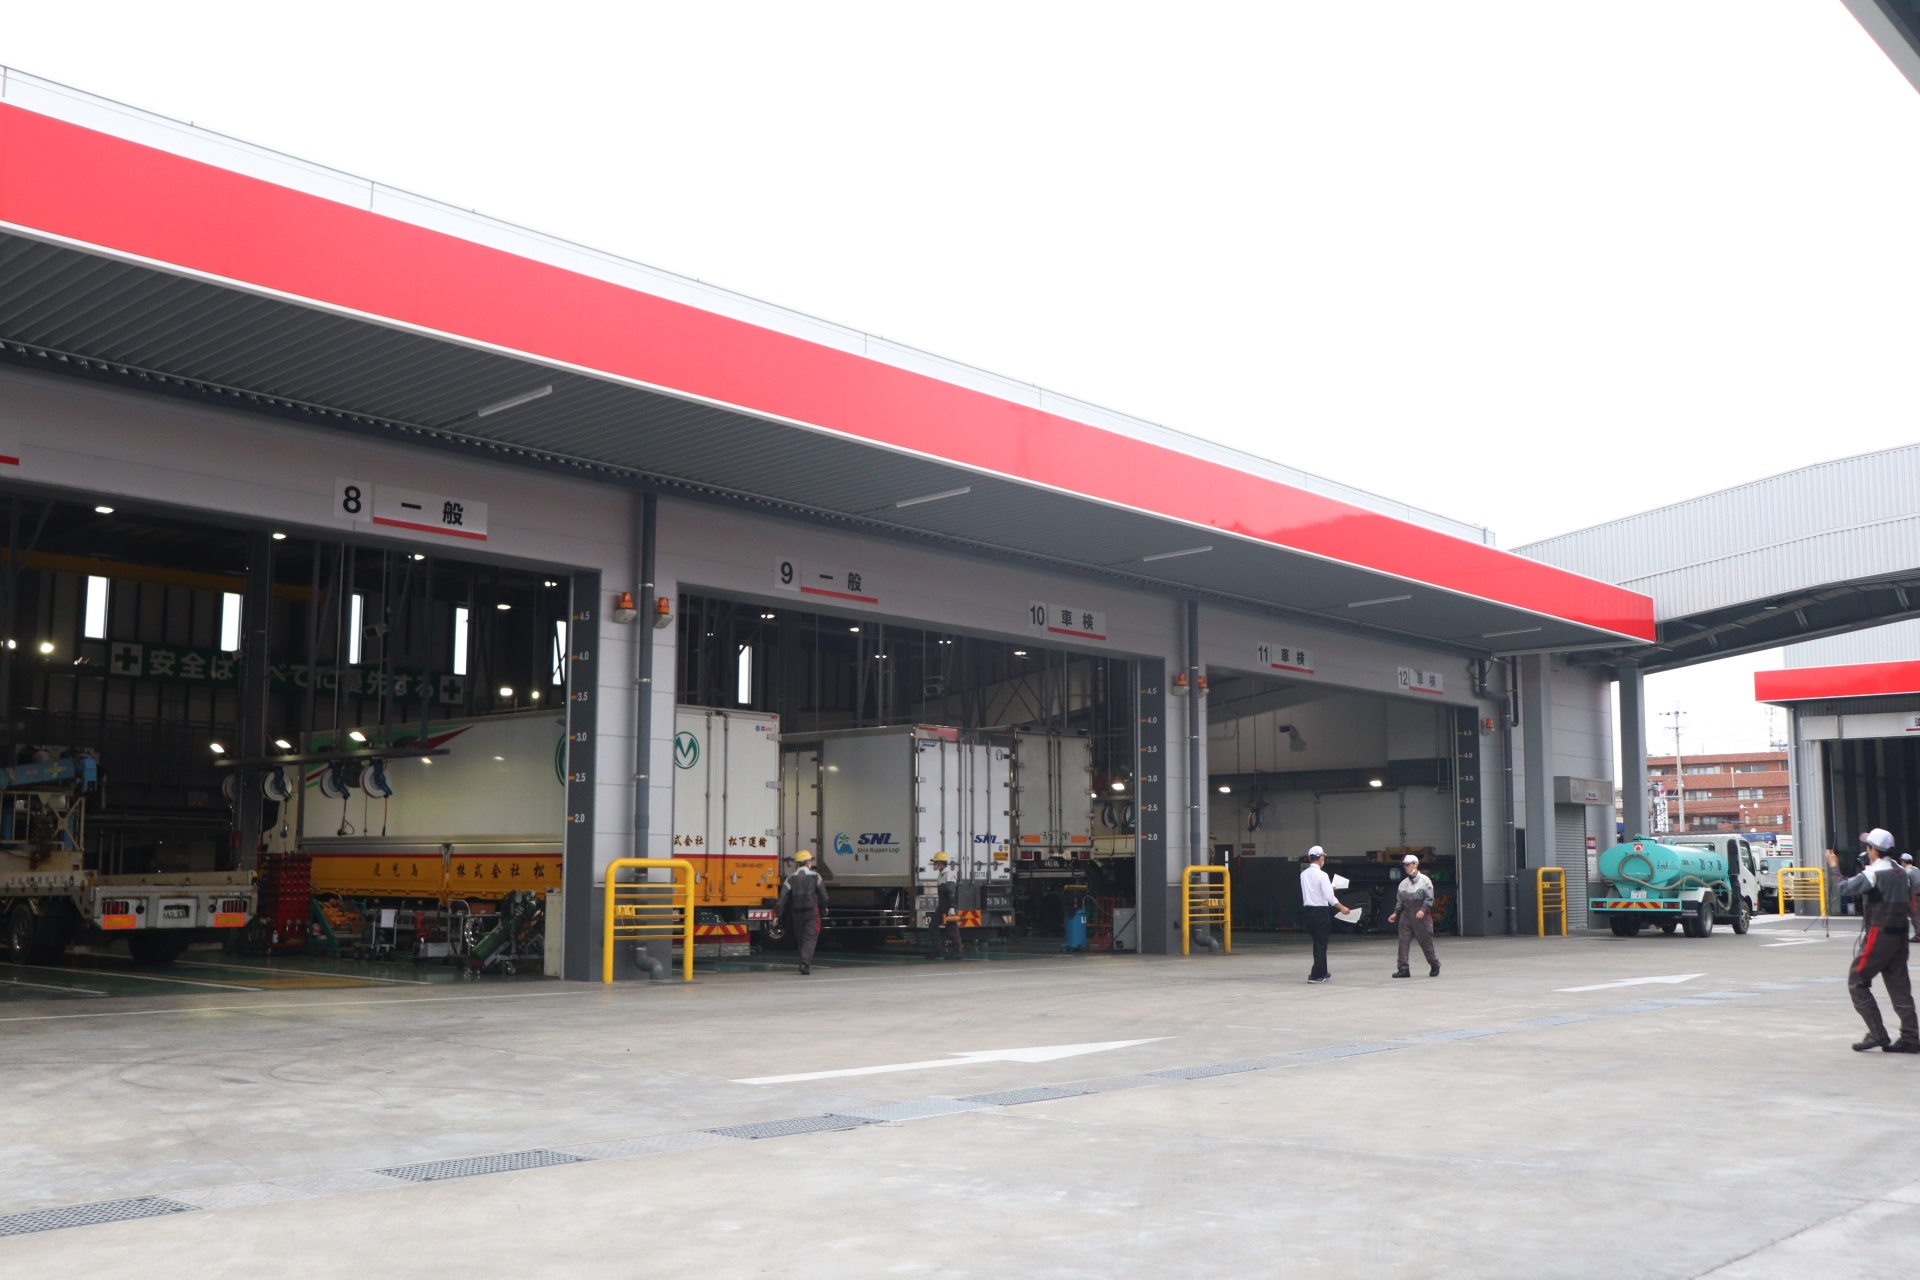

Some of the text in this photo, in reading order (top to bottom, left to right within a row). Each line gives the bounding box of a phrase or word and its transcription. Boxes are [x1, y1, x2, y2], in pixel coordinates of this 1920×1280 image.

[343, 485, 464, 526] 8 一般
[781, 561, 862, 592] 9 一般
[579, 611, 590, 620] 4.5
[1029, 605, 1094, 631] 10 車検
[578, 651, 589, 660] 4.0
[1258, 645, 1304, 666] 11 車検
[1399, 670, 1436, 688] 12 車検
[1147, 687, 1157, 695] 4.5
[577, 691, 588, 701] 3.5
[1147, 716, 1158, 724] 4.0
[576, 732, 587, 741] 3.0
[1147, 745, 1158, 753] 3.5
[575, 772, 586, 782] 2.5
[1147, 774, 1158, 782] 3.0
[1147, 804, 1158, 812] 2.5
[574, 813, 585, 823] 2.0
[857, 833, 900, 845] SNL
[1147, 833, 1158, 841] 2.0
